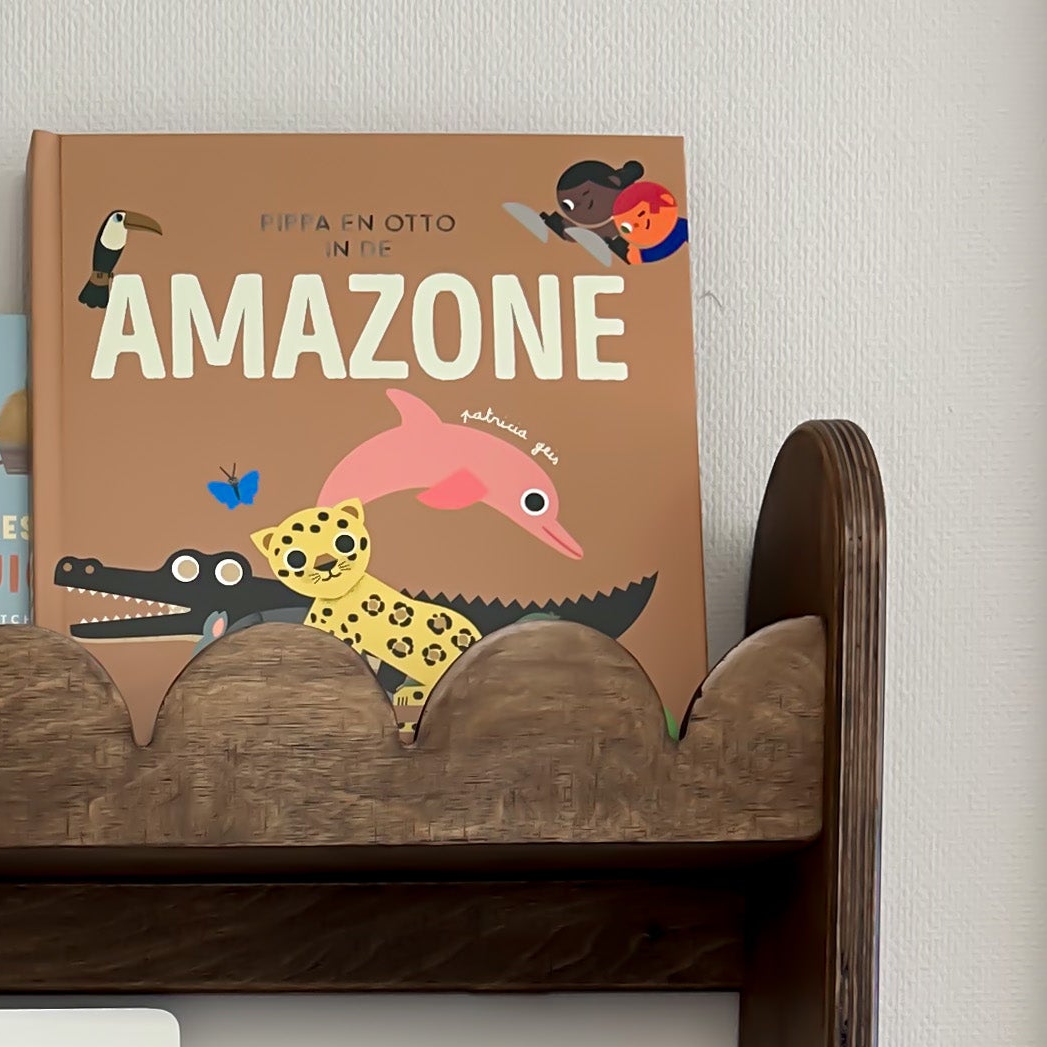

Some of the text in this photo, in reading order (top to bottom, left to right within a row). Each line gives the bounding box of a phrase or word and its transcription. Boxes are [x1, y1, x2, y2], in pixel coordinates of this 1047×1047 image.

[260, 213, 457, 232] PIPPA EN OTTO
[325, 240, 392, 257] IN DE
[91, 273, 629, 381] AMAZONE
[460, 407, 528, 440] patricia
